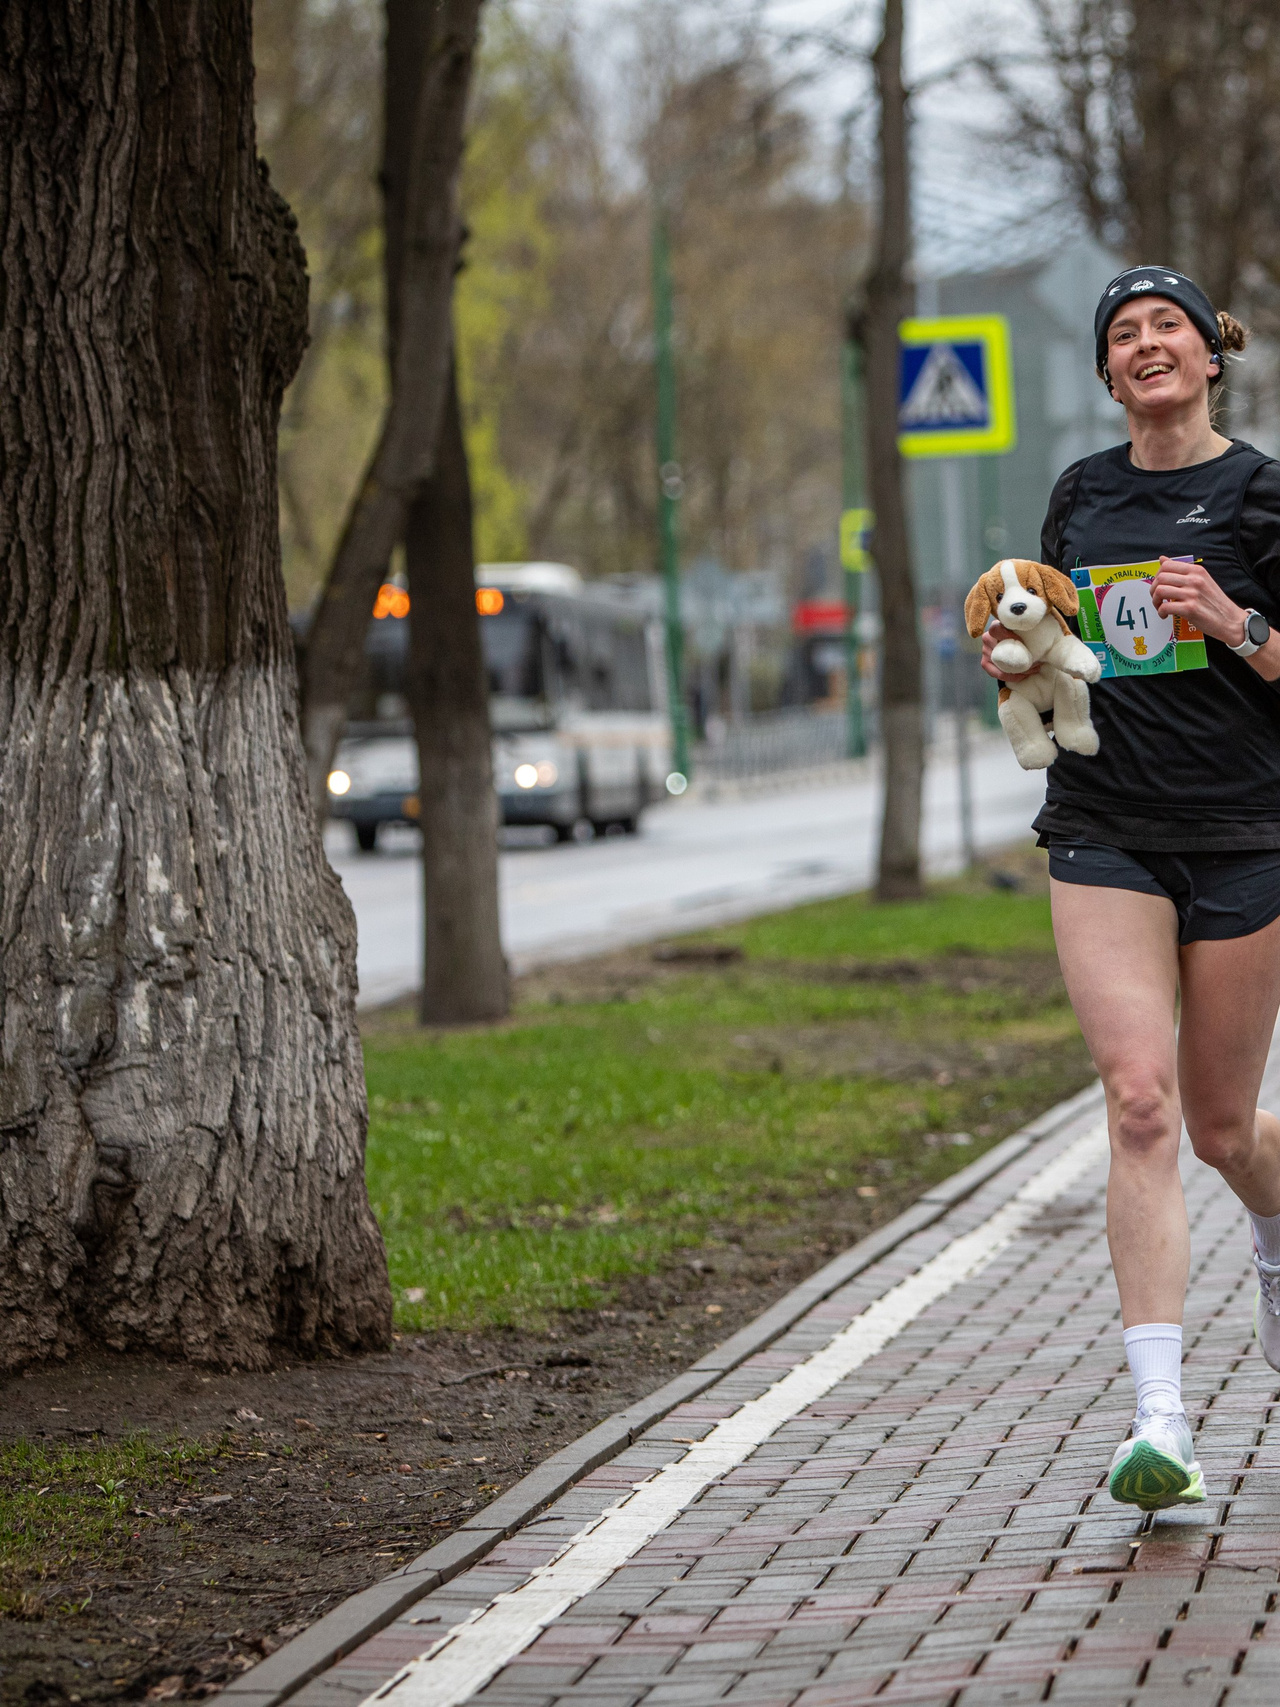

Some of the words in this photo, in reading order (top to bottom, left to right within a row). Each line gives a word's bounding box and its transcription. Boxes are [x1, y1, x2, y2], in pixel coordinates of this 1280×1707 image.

[1096, 576, 1115, 600] DREAM
[1113, 569, 1134, 580] TRAIL
[1134, 570, 1156, 583] LYSKO
[1094, 611, 1104, 632] TRAIL
[1115, 596, 1149, 630] 41
[1099, 632, 1115, 656] ULTRA
[1114, 654, 1142, 671] KANNAS
[1152, 655, 1165, 668] ЛЕС
